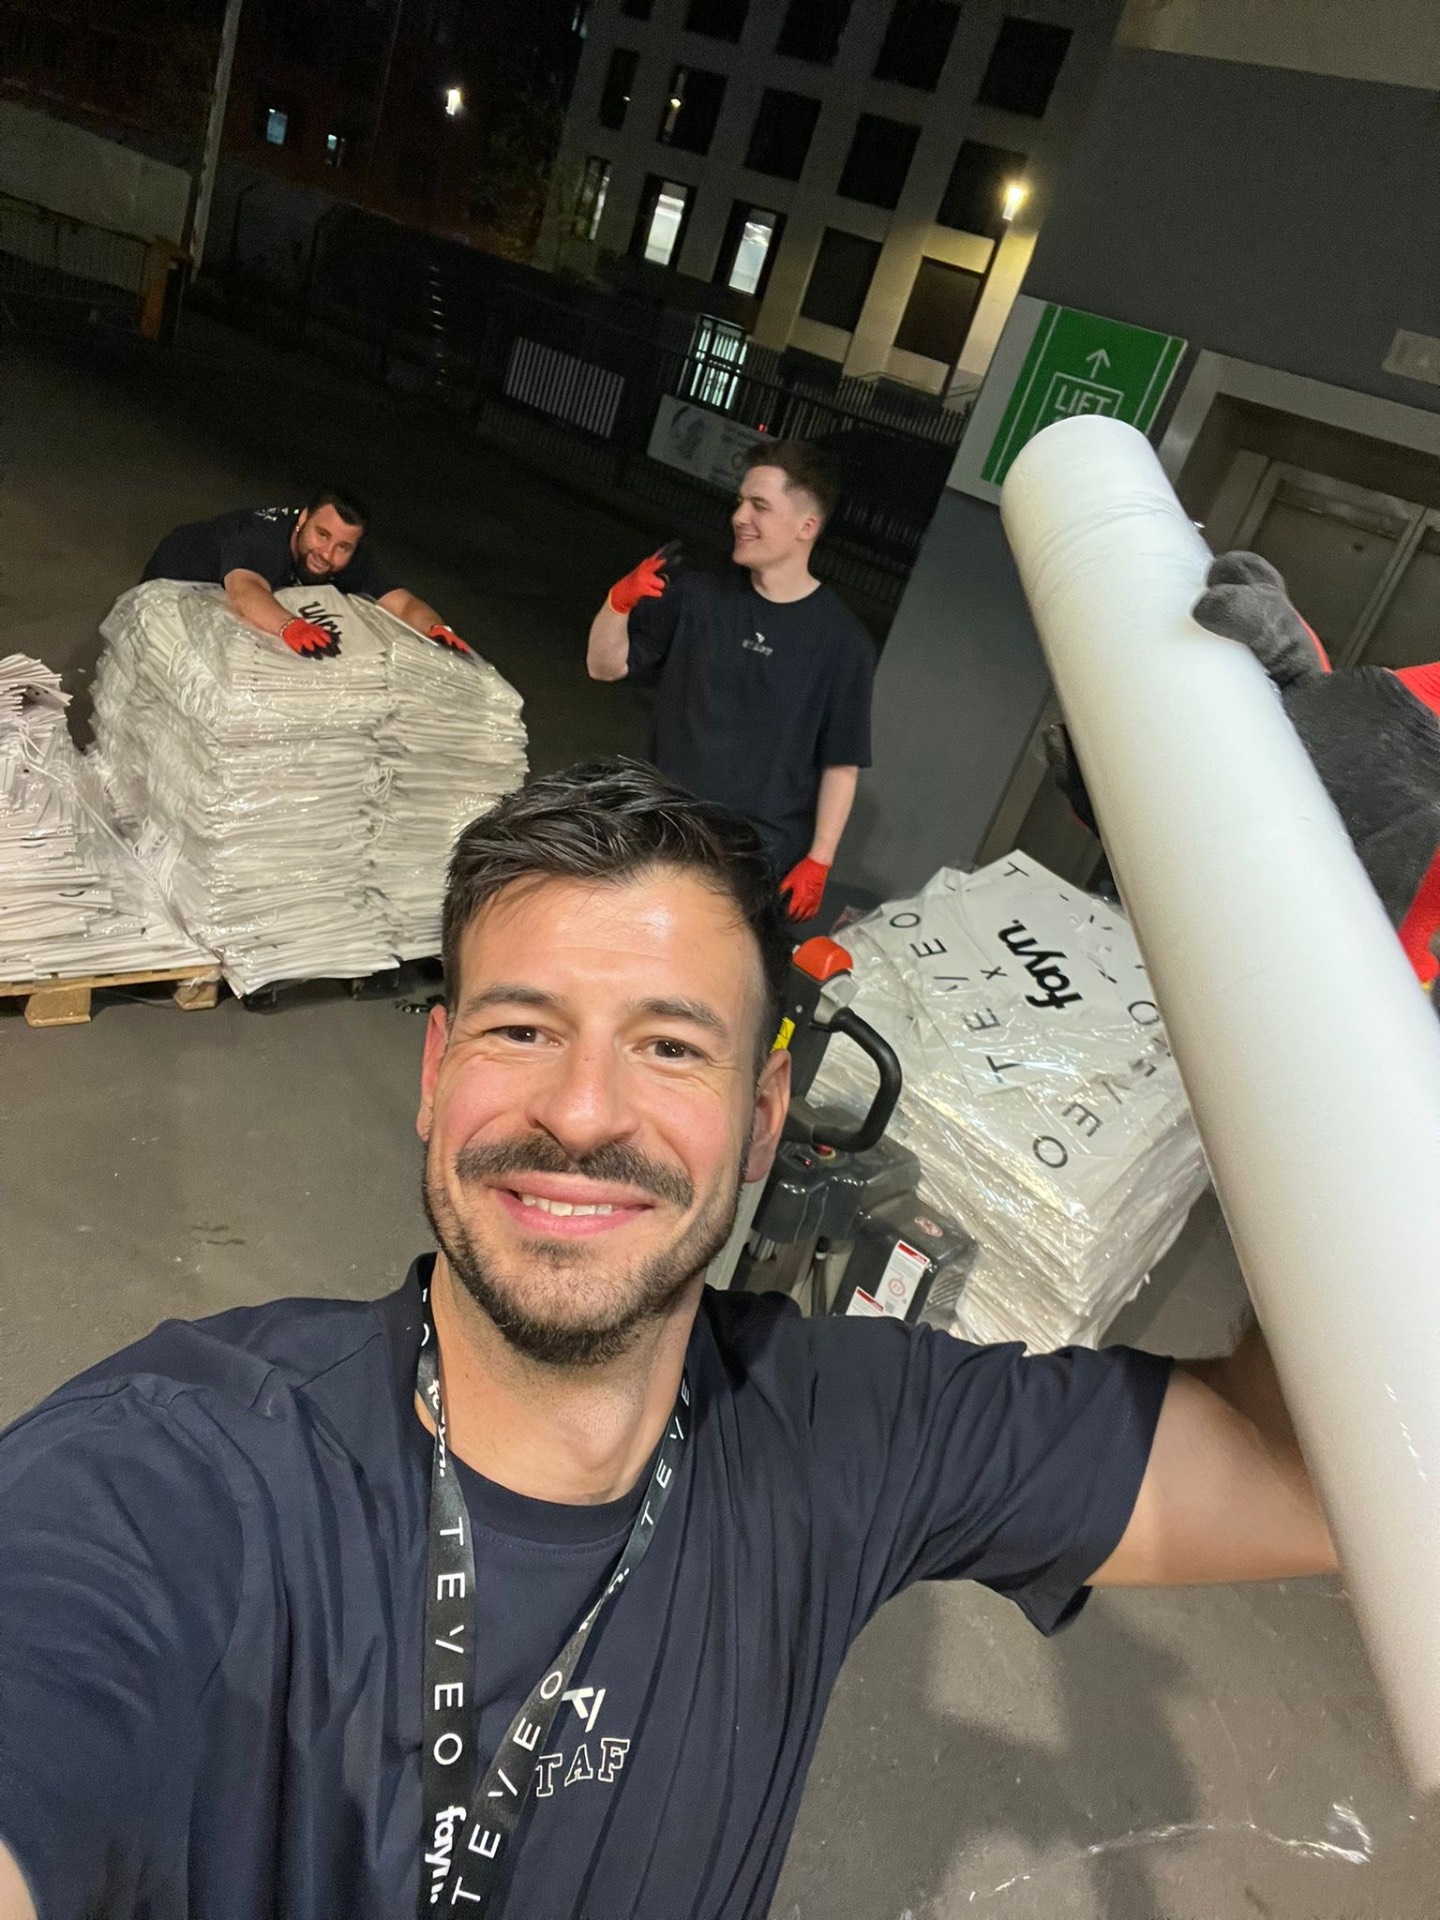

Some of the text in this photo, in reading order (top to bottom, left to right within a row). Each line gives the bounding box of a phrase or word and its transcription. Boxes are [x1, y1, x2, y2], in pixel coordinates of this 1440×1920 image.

[1054, 384, 1112, 415] LIFT
[997, 918, 1084, 1010] fayn.
[433, 1516, 466, 1766] TEVEO
[450, 1670, 563, 1906] TEVEO
